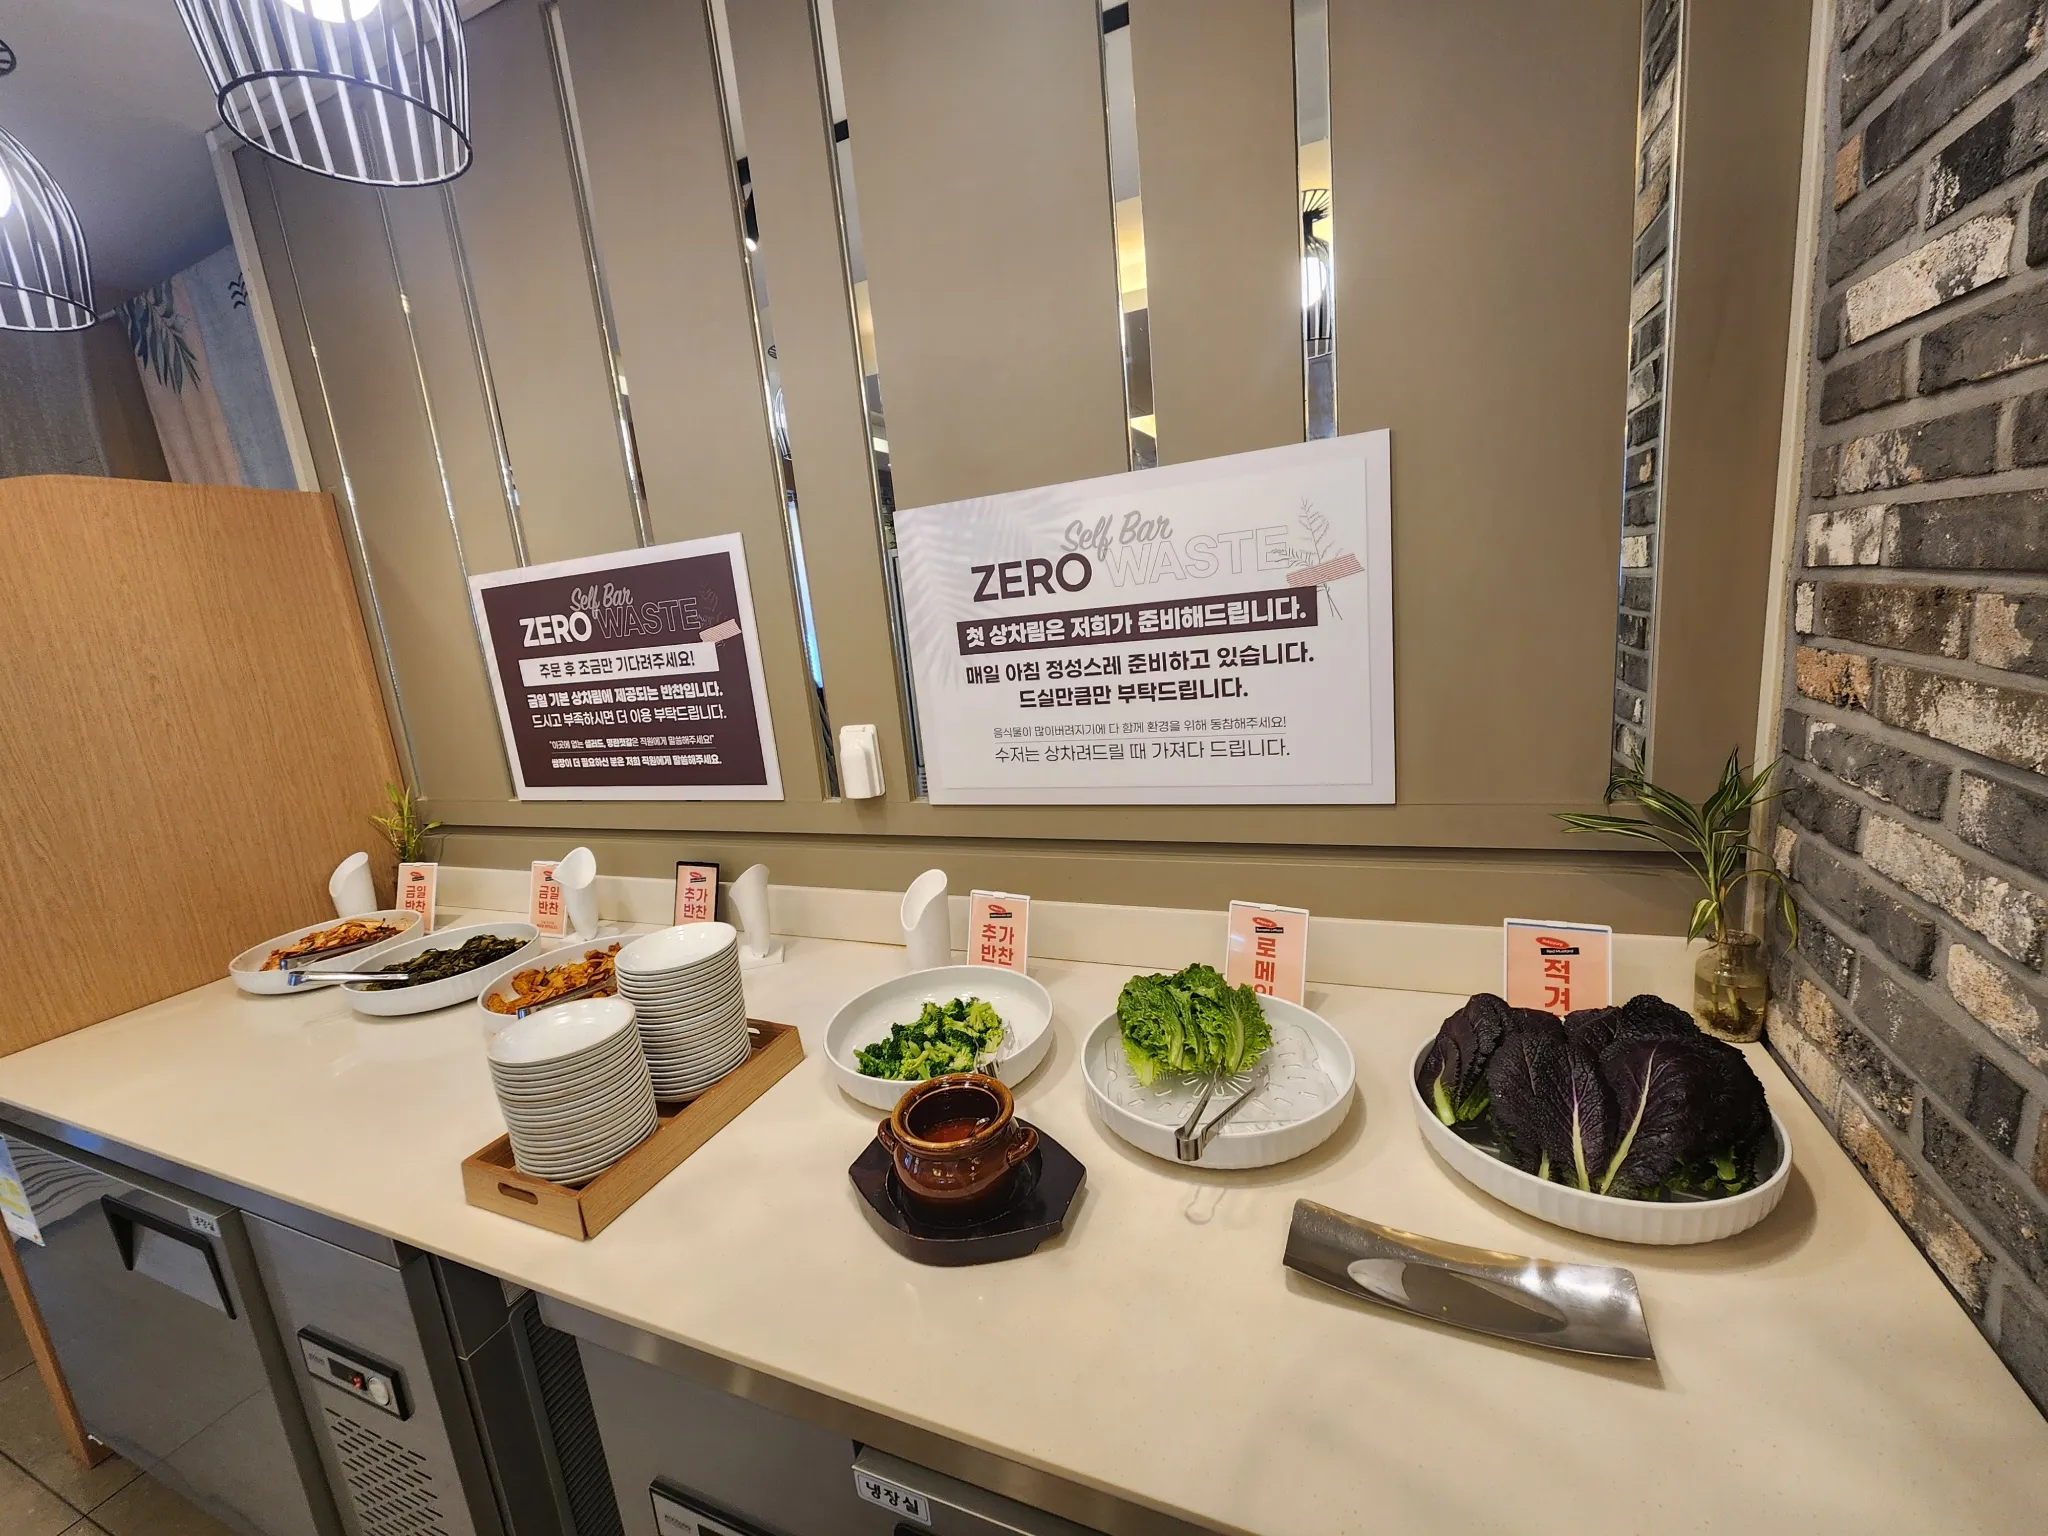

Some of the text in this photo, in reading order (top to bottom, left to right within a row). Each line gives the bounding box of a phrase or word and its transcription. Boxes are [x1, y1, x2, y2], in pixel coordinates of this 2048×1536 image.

[1060, 510, 1173, 562] Self Bar
[971, 525, 1290, 603] ZERO WASTE
[570, 582, 633, 619] Self Bar
[519, 597, 701, 647] ZERO WASTE
[966, 596, 1307, 649] 첫 상차림은 저희가 준비해드립니다.
[539, 650, 695, 679] 주문 후 조금만 기다려주세요!
[966, 641, 1315, 685] 매일 아침 정성스레 준비하고 있습니다.
[527, 681, 724, 709] 금일 기본 상차림에 제공되는 반찬입니다.
[1019, 677, 1249, 709] 드실만큼만 부탁드립니다.
[532, 704, 727, 729] 드시고 부족하시면 더 이용 부탁드립니다.
[993, 716, 1287, 739] 음식물이 많이버려지기에 다 함께 환경을 위해 동참해주세요!
[571, 739, 585, 749] 없는
[640, 736, 668, 747] 직원에게
[995, 738, 1291, 764] 수저는 상차려드릴 때 가져다 드립니다.
[573, 757, 581, 768] 더
[581, 756, 610, 768] 필요하신
[610, 755, 625, 768] 분은
[625, 755, 641, 767] 저희
[642, 754, 672, 767] 직원에게
[672, 753, 723, 766] 말씀해주세요.
[406, 885, 427, 899] 금일
[539, 885, 560, 900] 금일
[684, 887, 708, 903] 추가
[538, 901, 559, 916] 반찬
[683, 903, 707, 920] 반찬
[981, 923, 1015, 945] 추가
[981, 943, 1014, 966] 반찬
[1544, 958, 1570, 1012] 적겨
[865, 1481, 919, 1516] 냉장실
